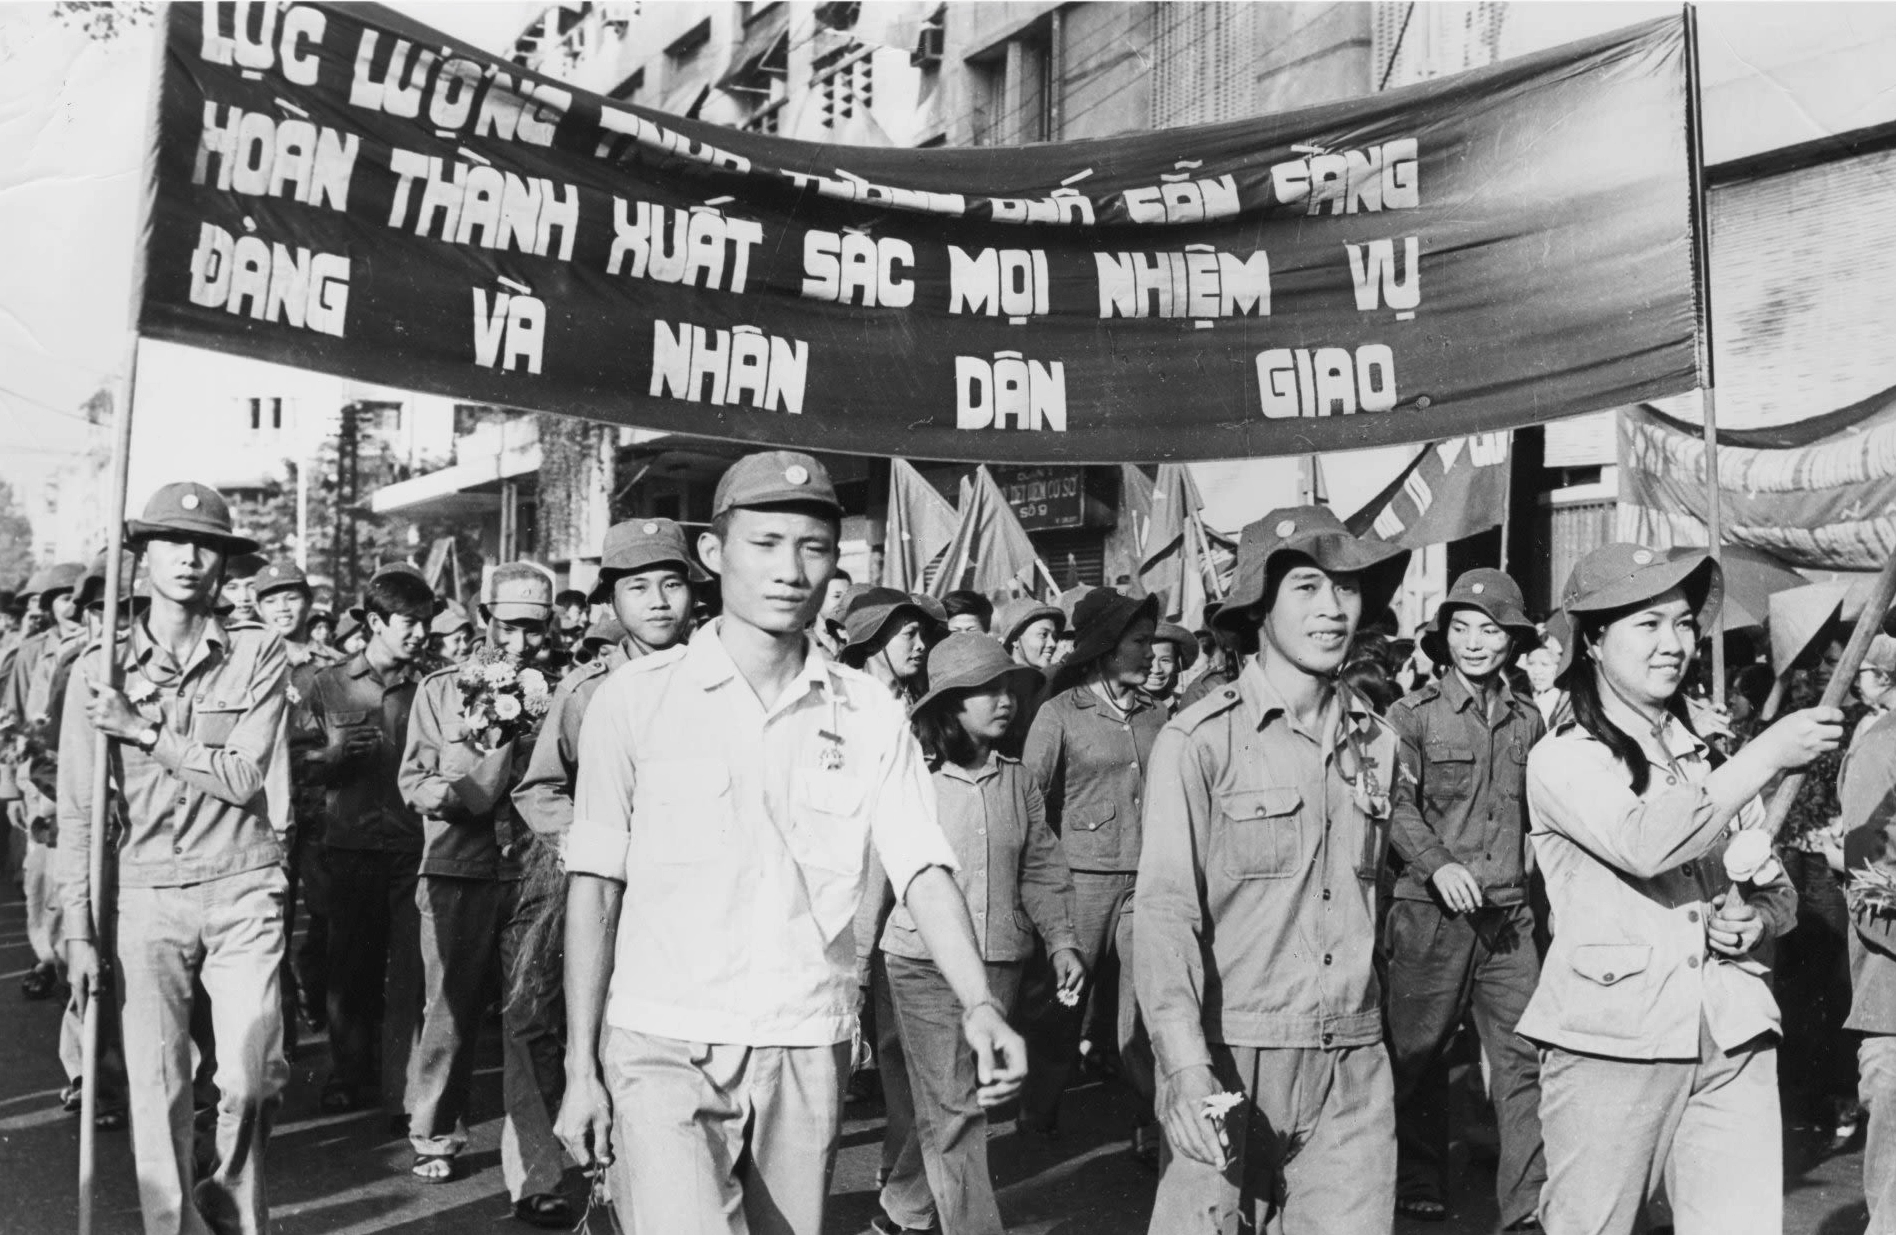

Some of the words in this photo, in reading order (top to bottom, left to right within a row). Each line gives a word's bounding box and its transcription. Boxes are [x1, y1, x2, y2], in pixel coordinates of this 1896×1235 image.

[192, 97, 359, 212] HOÀN
[388, 146, 579, 261] THÀNH
[606, 195, 763, 294] XUẤT
[948, 245, 1049, 325] MỌI
[1094, 243, 1271, 328] NHIỆM
[1343, 236, 1421, 321] VỤ
[200, 1, 327, 86] LỰC
[349, 28, 572, 147] LƯỢNG
[1270, 138, 1419, 216] SÀNG
[189, 215, 351, 338] ĐẢNG
[472, 275, 546, 374] VÀ
[649, 319, 809, 414] NHÂN
[955, 350, 1067, 432] DÂN
[1255, 343, 1396, 418] GIAO
